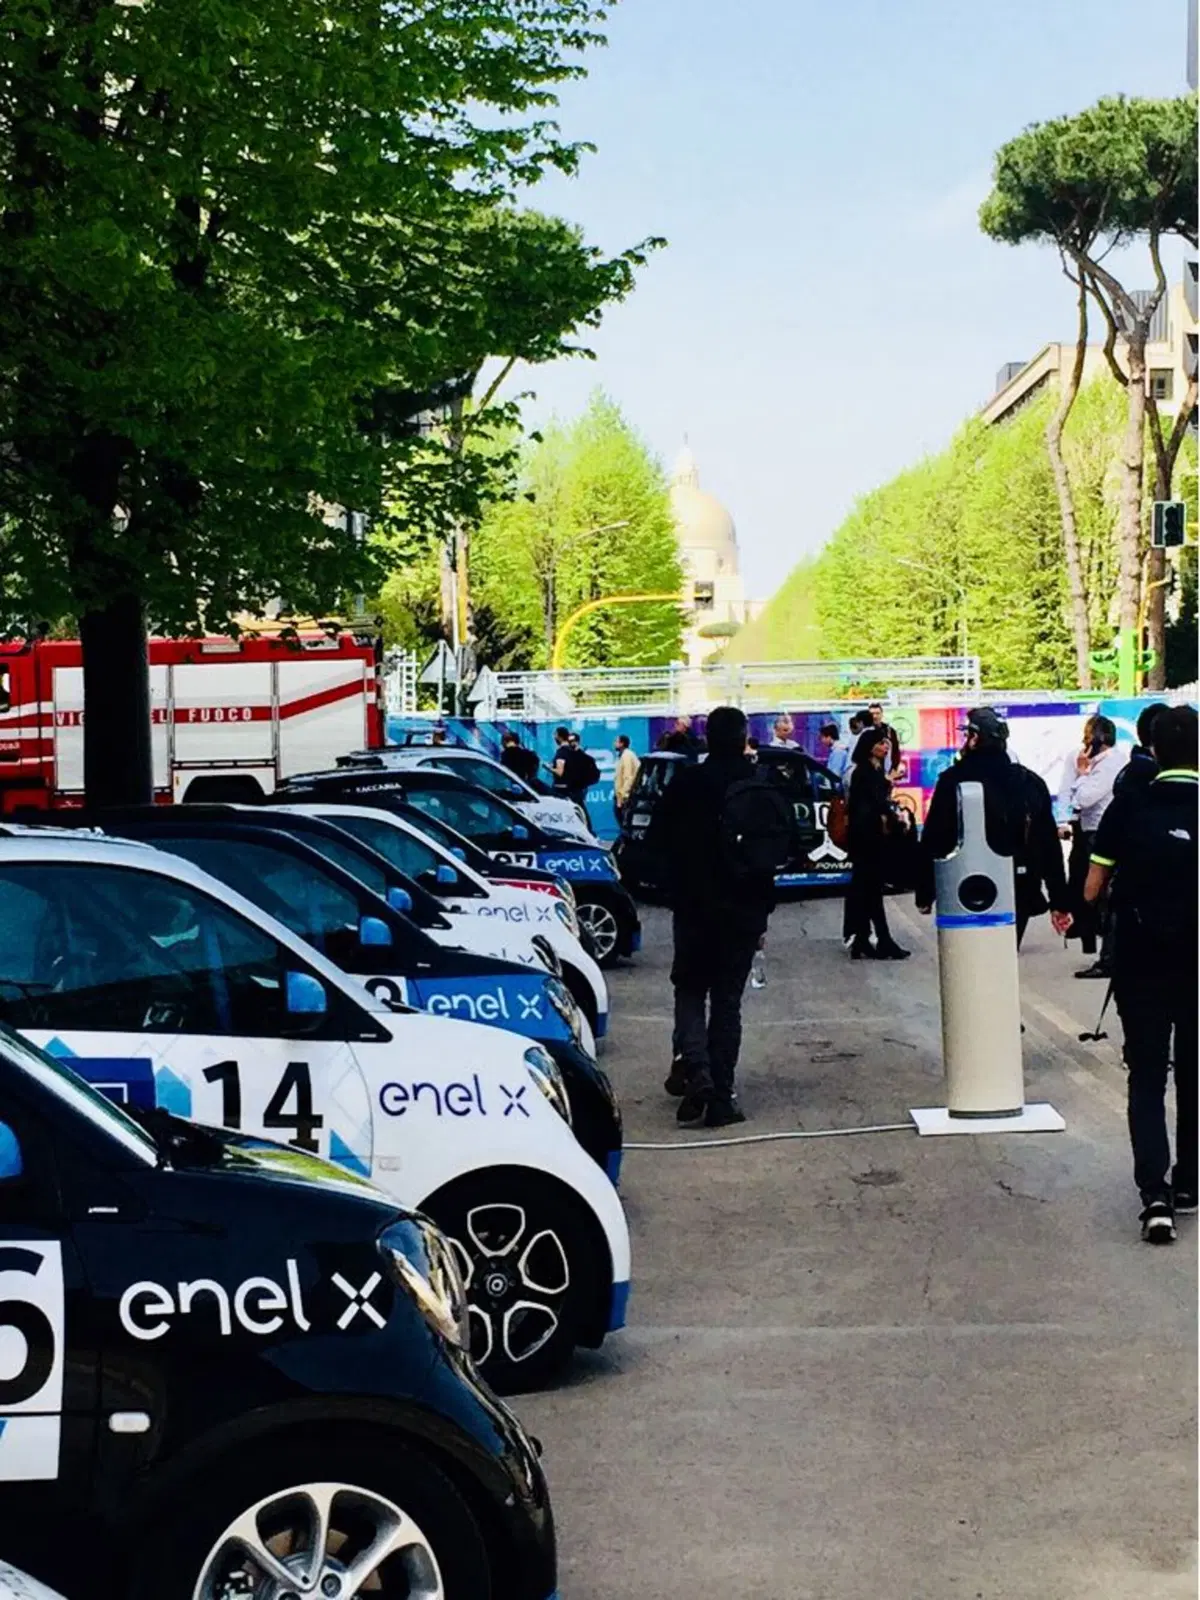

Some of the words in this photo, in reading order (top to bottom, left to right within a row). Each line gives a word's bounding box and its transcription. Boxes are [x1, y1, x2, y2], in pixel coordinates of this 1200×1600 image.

[188, 707, 252, 722] FUOCO
[534, 811, 564, 823] enel
[545, 856, 585, 873] enel
[589, 859, 602, 872] x
[477, 903, 530, 922] enel
[536, 906, 551, 922] x
[427, 987, 509, 1021] enel
[517, 994, 543, 1019] x
[203, 1060, 323, 1153] 14
[379, 1074, 486, 1118] enel
[500, 1084, 530, 1117] x
[119, 1259, 311, 1340] enel
[331, 1271, 387, 1330] x
